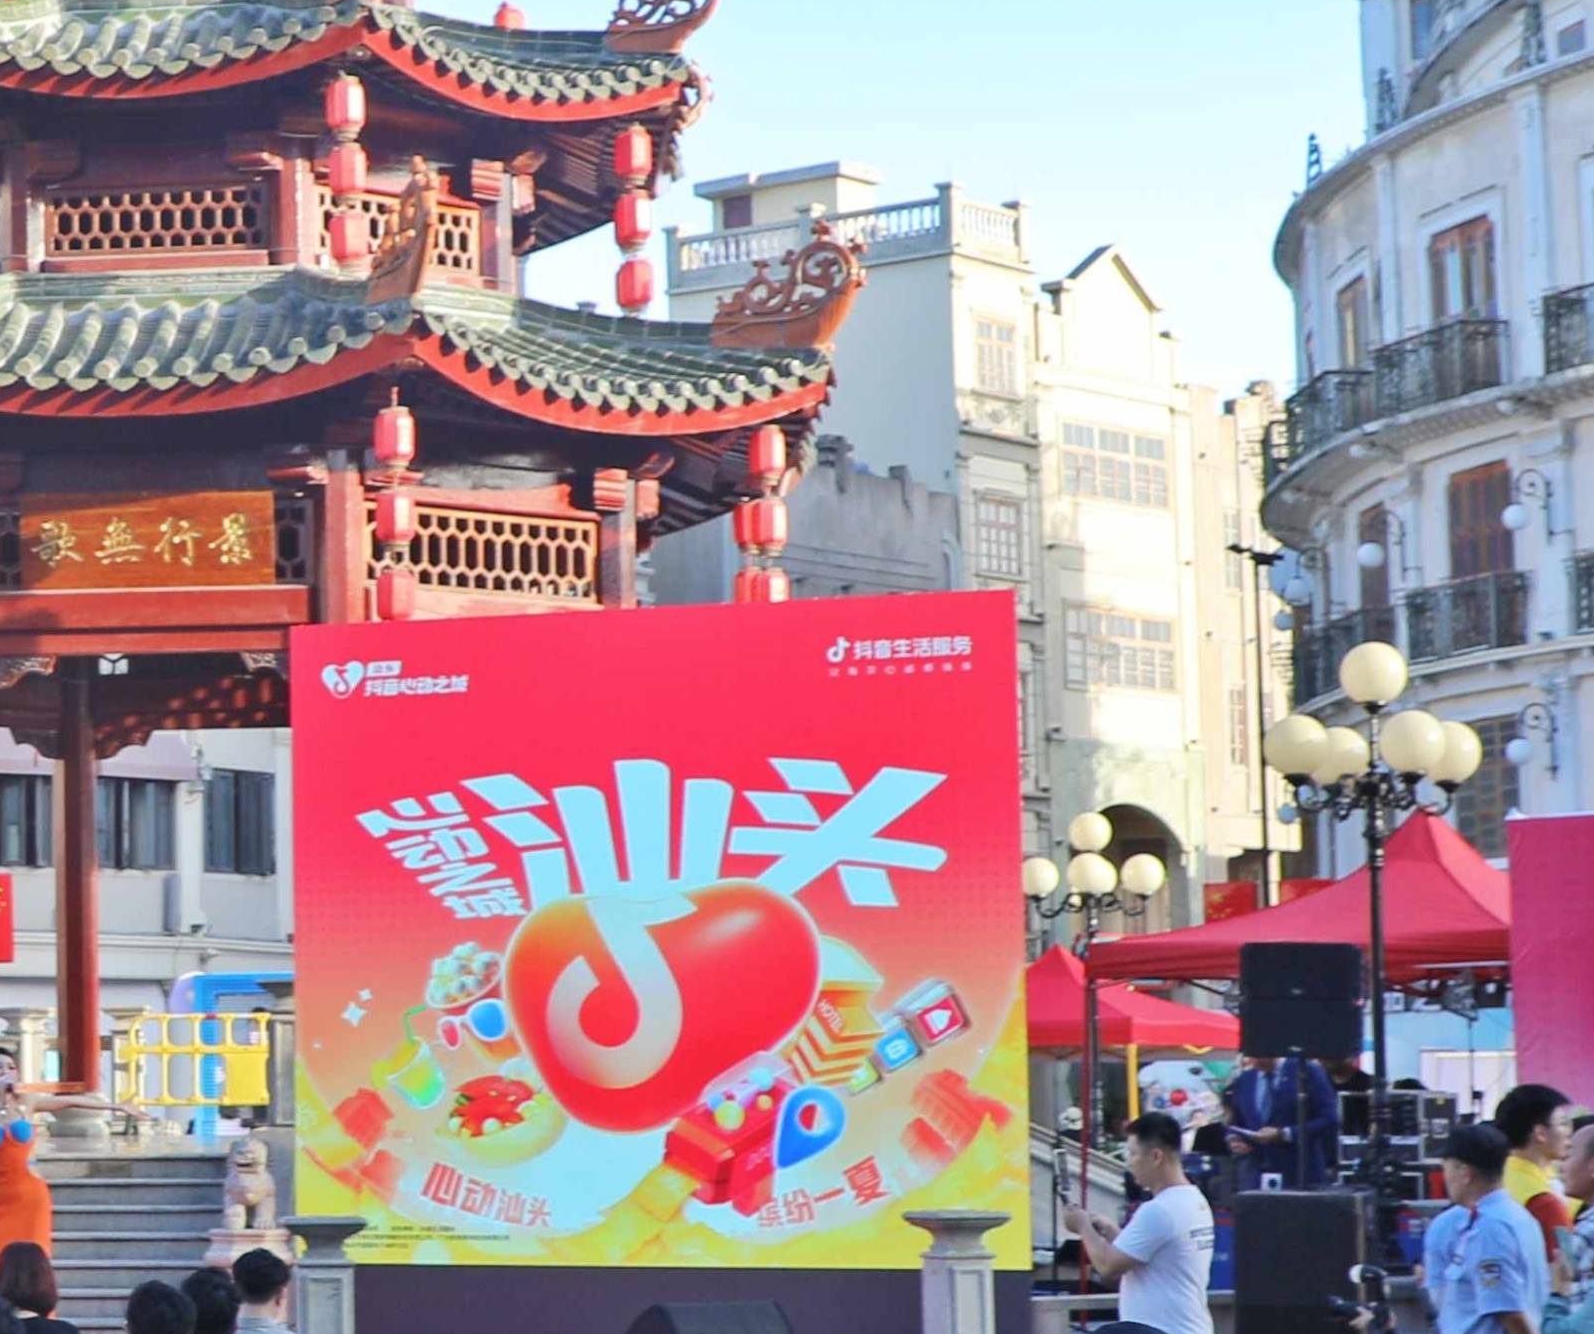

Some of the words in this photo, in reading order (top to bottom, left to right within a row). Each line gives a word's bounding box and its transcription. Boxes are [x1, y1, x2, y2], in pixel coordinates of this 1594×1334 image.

[458, 757, 950, 909] 汕头
[419, 1161, 554, 1229] 心动汕头
